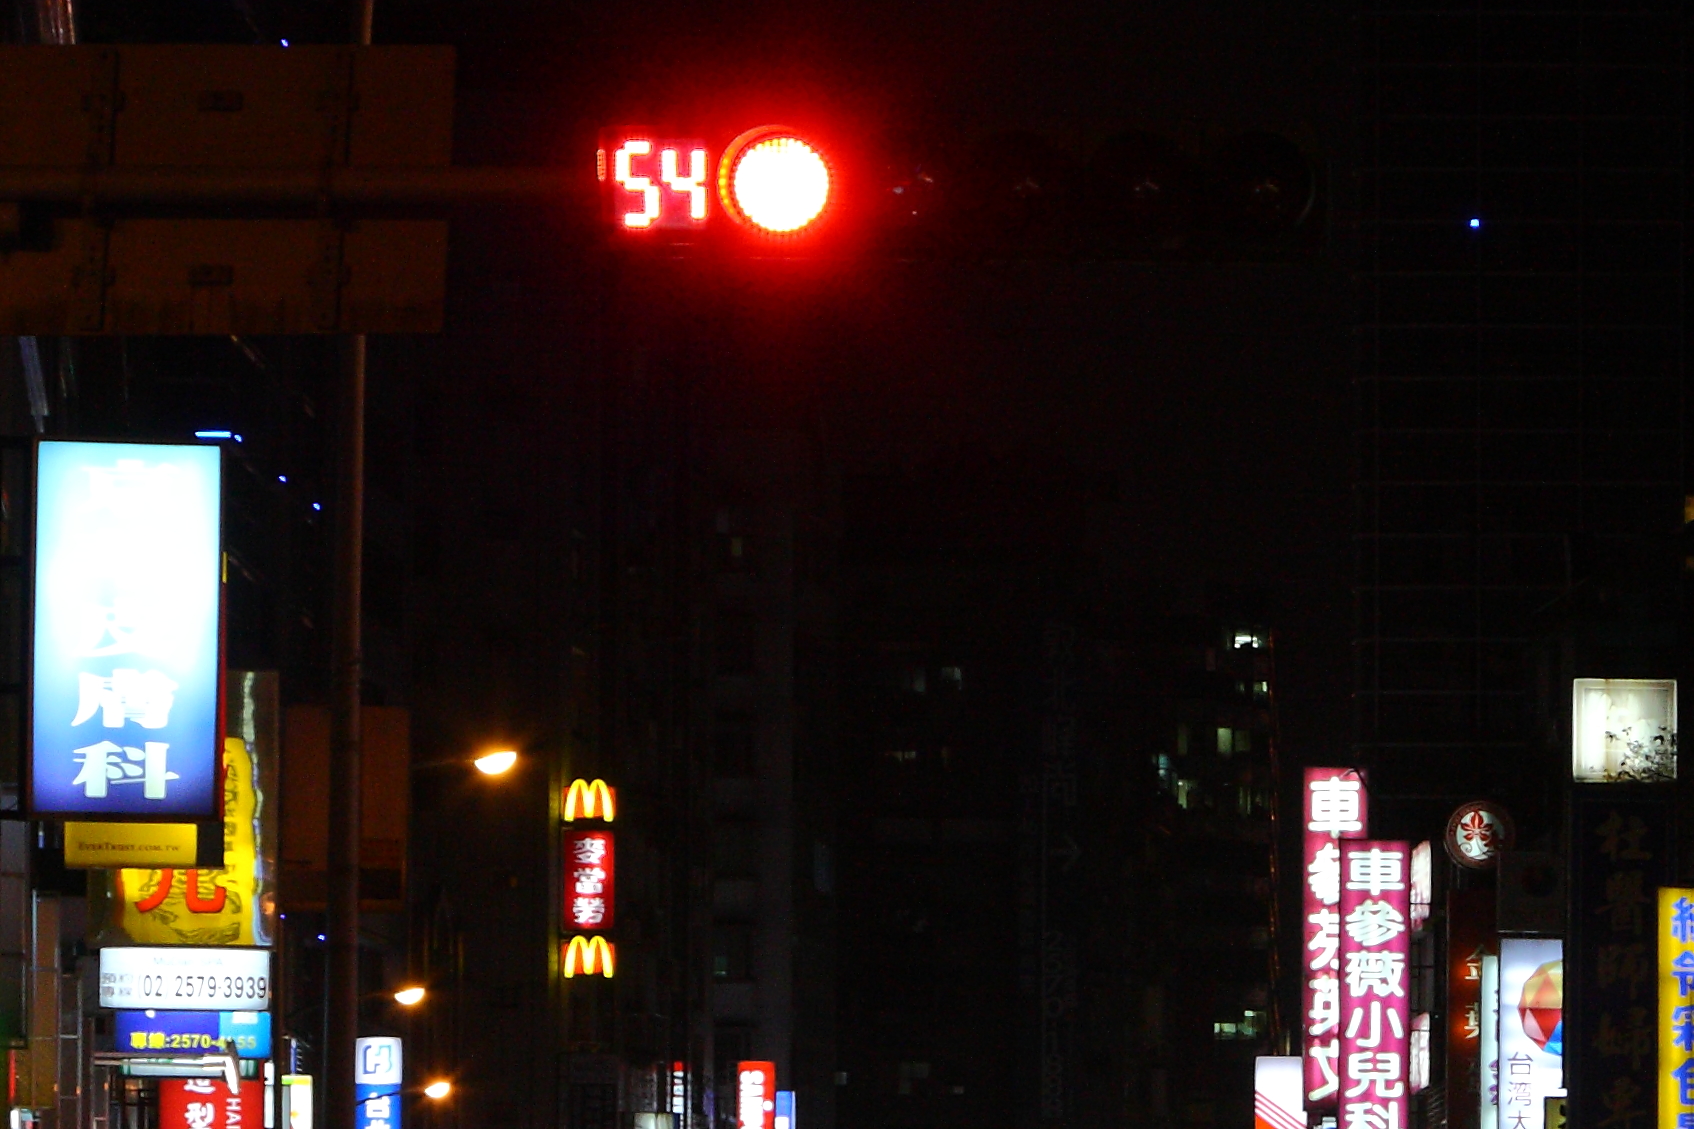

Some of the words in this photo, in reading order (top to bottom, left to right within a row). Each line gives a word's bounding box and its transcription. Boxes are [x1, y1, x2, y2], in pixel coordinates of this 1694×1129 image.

[614, 138, 707, 229] 54
[573, 838, 605, 924] 麥當勞
[175, 975, 267, 999] 2579-3939
